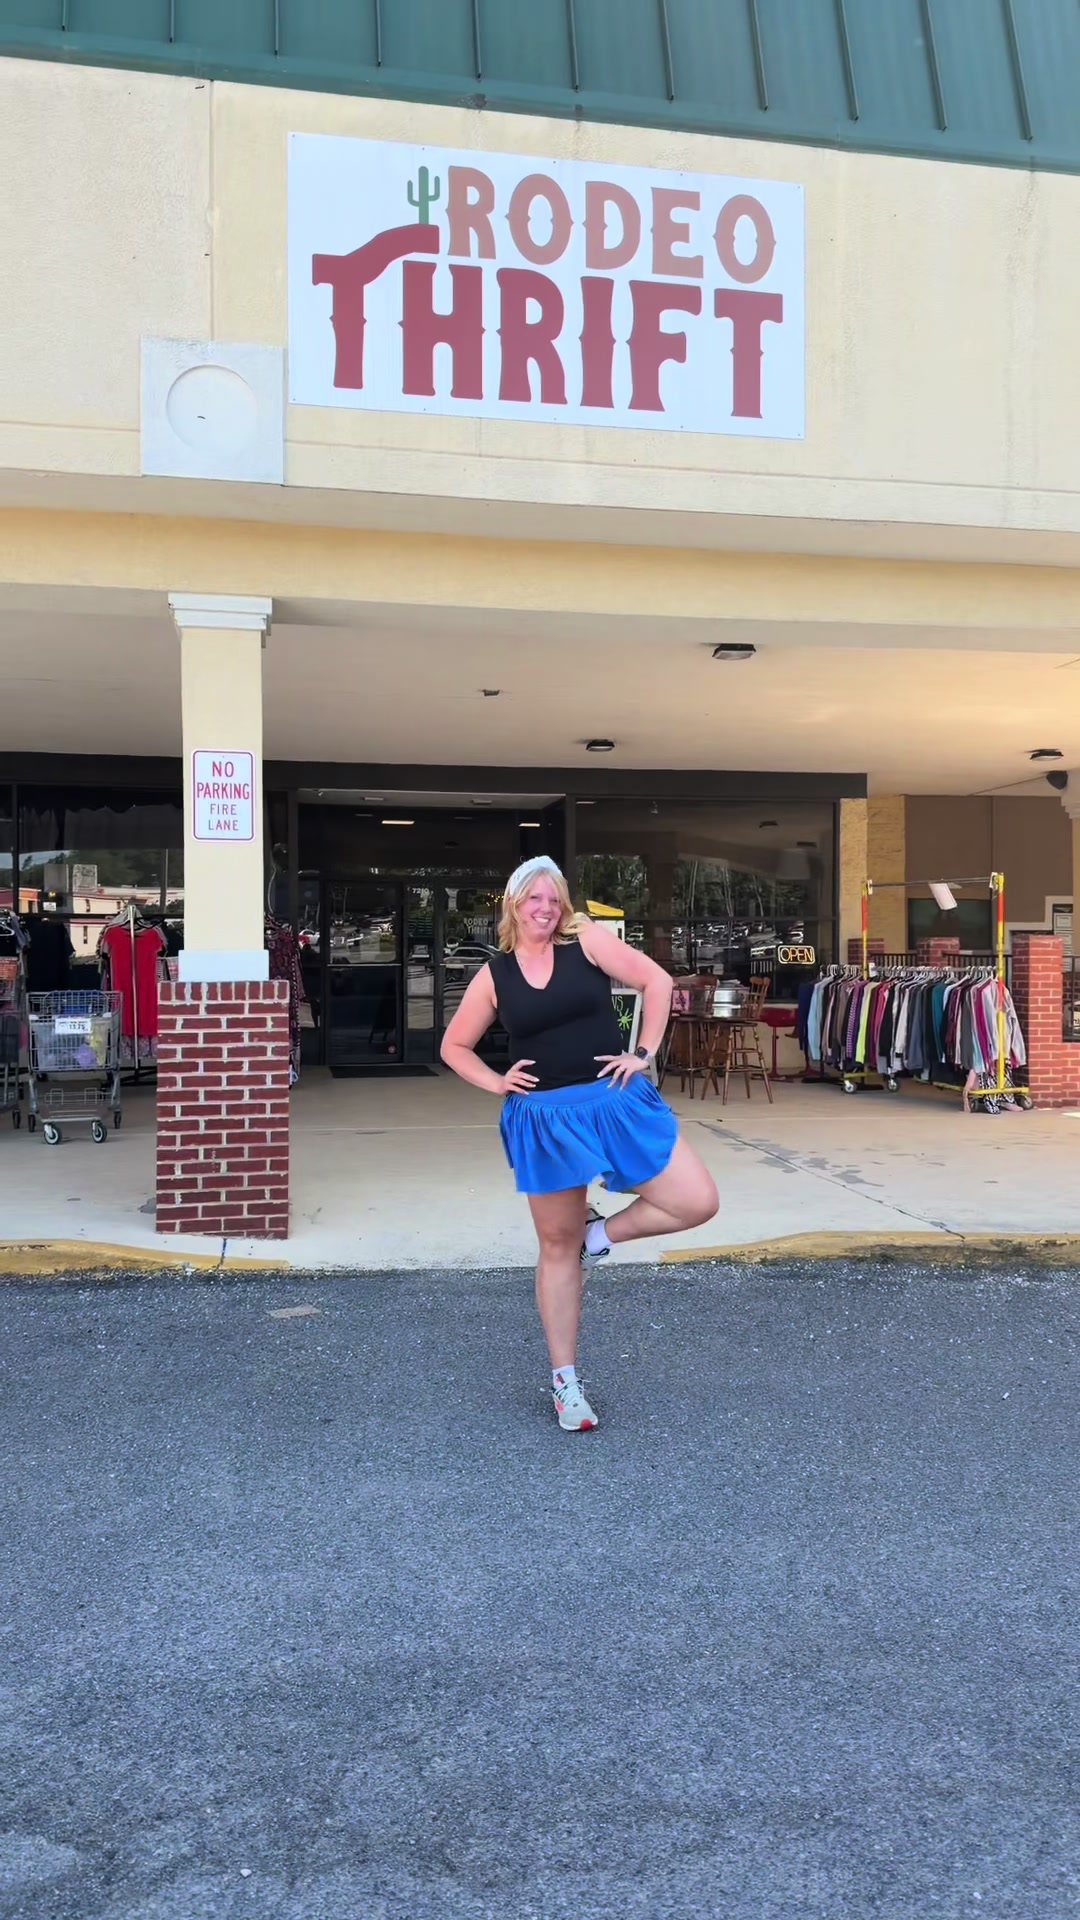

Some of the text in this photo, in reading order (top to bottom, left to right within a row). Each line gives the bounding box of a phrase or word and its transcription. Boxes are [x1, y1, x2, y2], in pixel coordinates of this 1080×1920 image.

[446, 165, 777, 284] RODEO
[312, 223, 784, 419] THRIFT
[212, 760, 234, 778] NO
[197, 782, 250, 800] PARKING
[210, 803, 237, 816] FIRE
[208, 819, 239, 831] LANE
[464, 918, 488, 926] RODEO
[467, 926, 492, 934] THRIFT
[780, 947, 813, 962] OPEN
